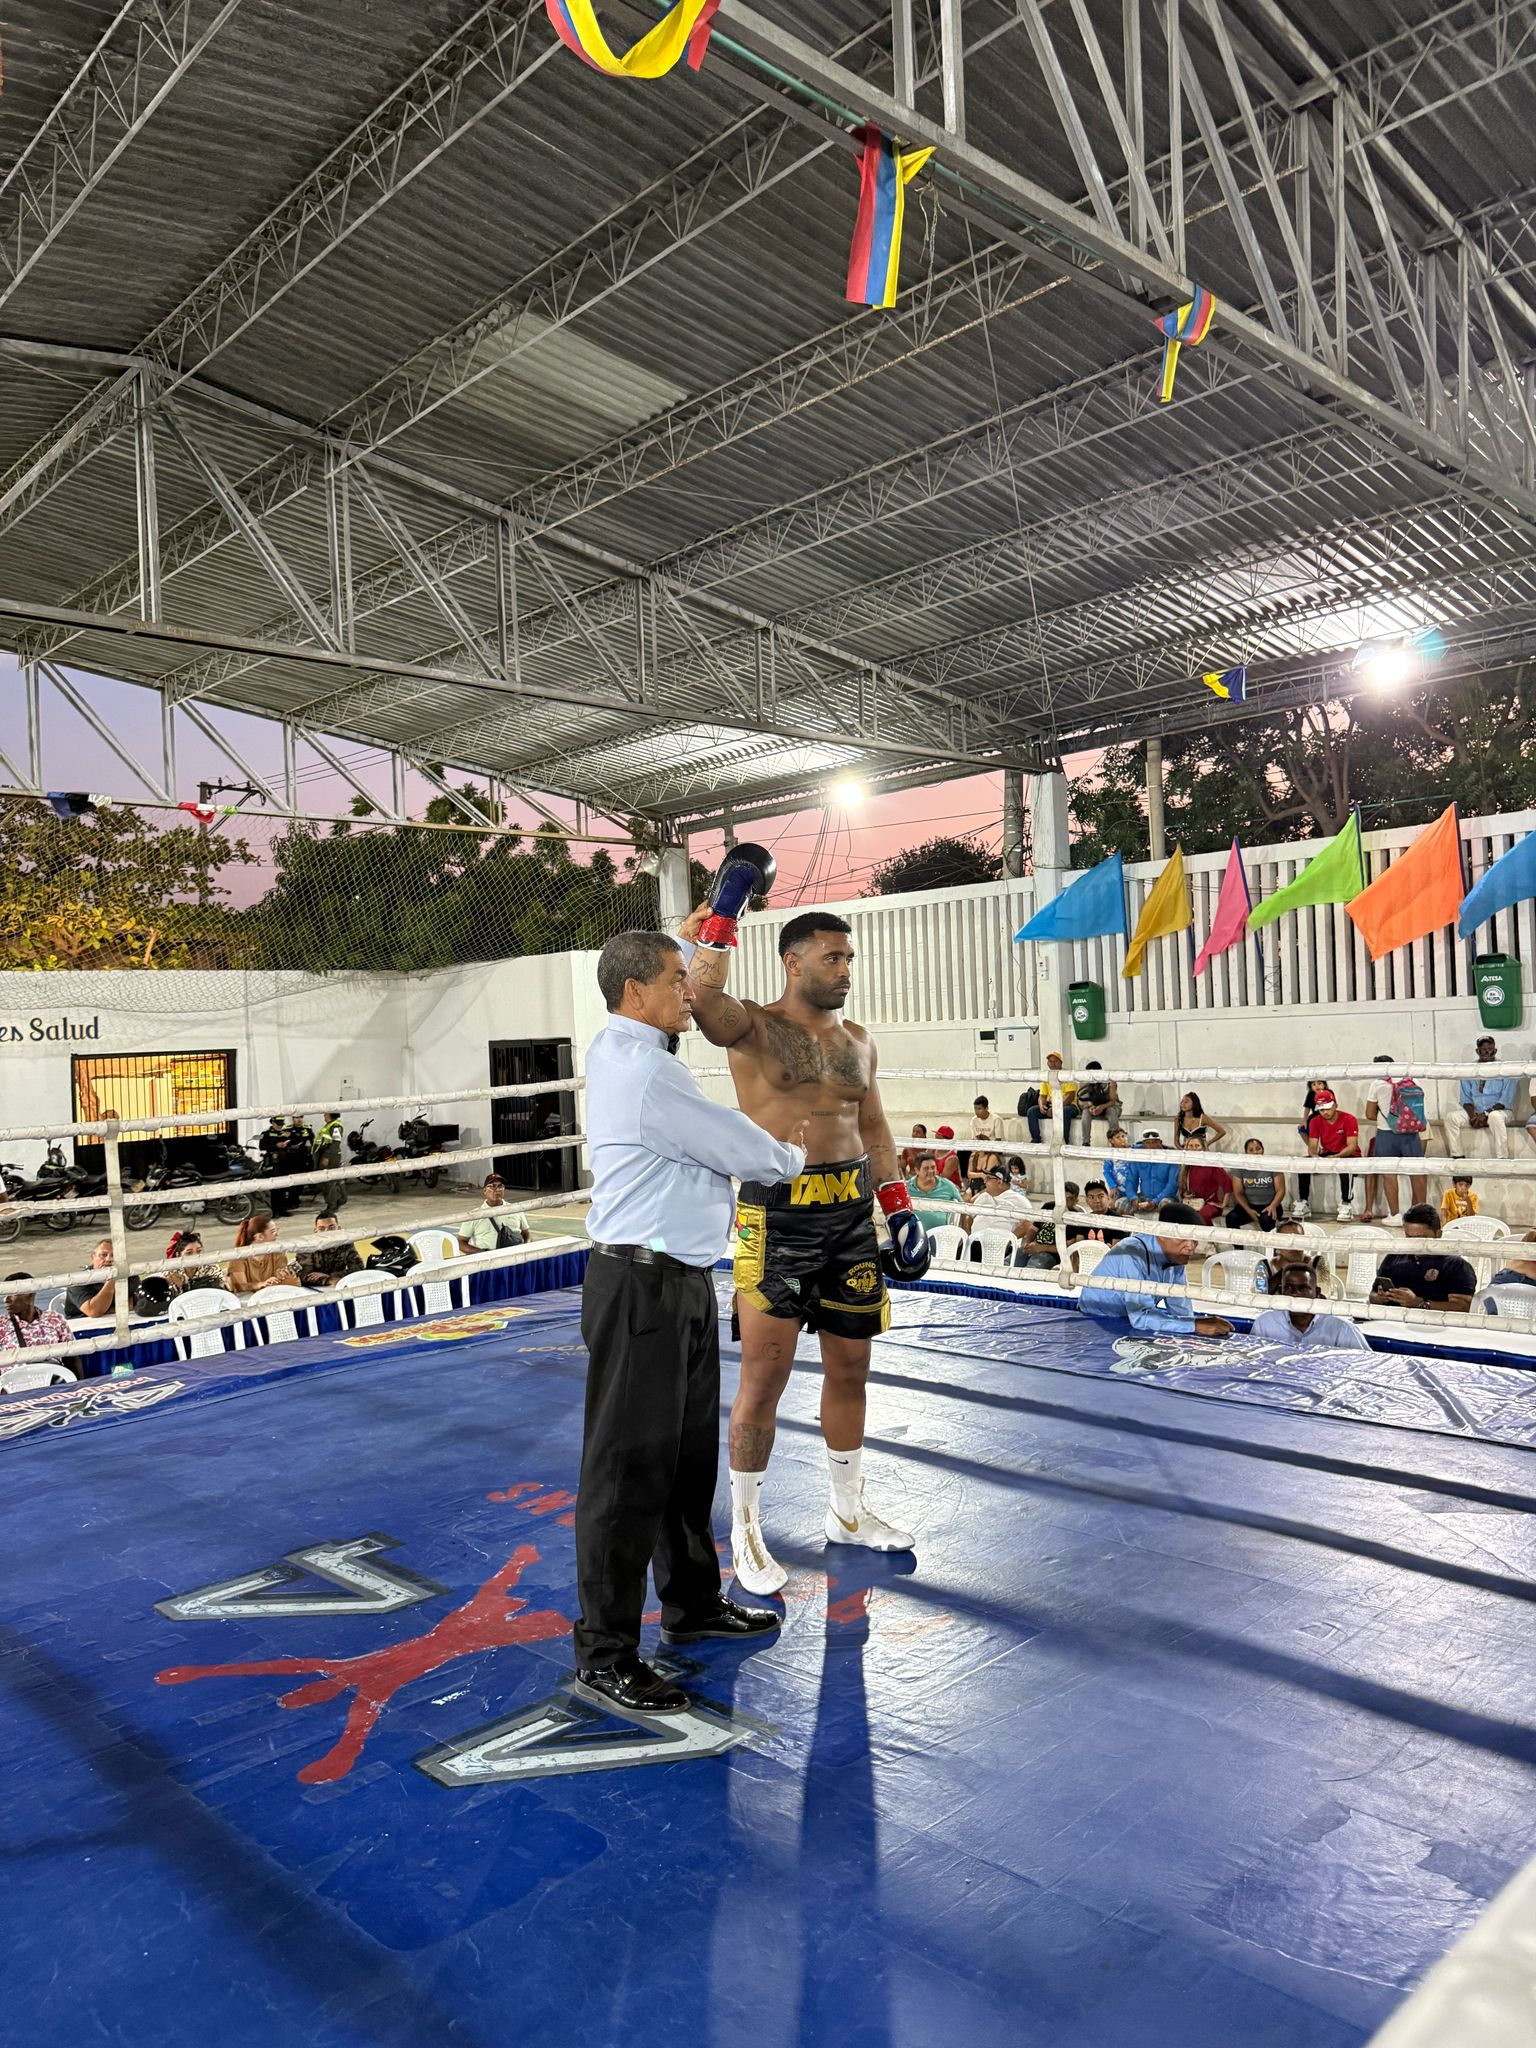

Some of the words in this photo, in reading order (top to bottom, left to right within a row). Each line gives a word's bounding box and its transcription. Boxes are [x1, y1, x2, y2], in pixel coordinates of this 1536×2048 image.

[1480, 975, 1503, 983] ATESA
[30, 1016, 103, 1041] Salud
[783, 1168, 861, 1206] TANK
[1243, 1176, 1273, 1185] YOUNG
[847, 1261, 877, 1276] ROUND
